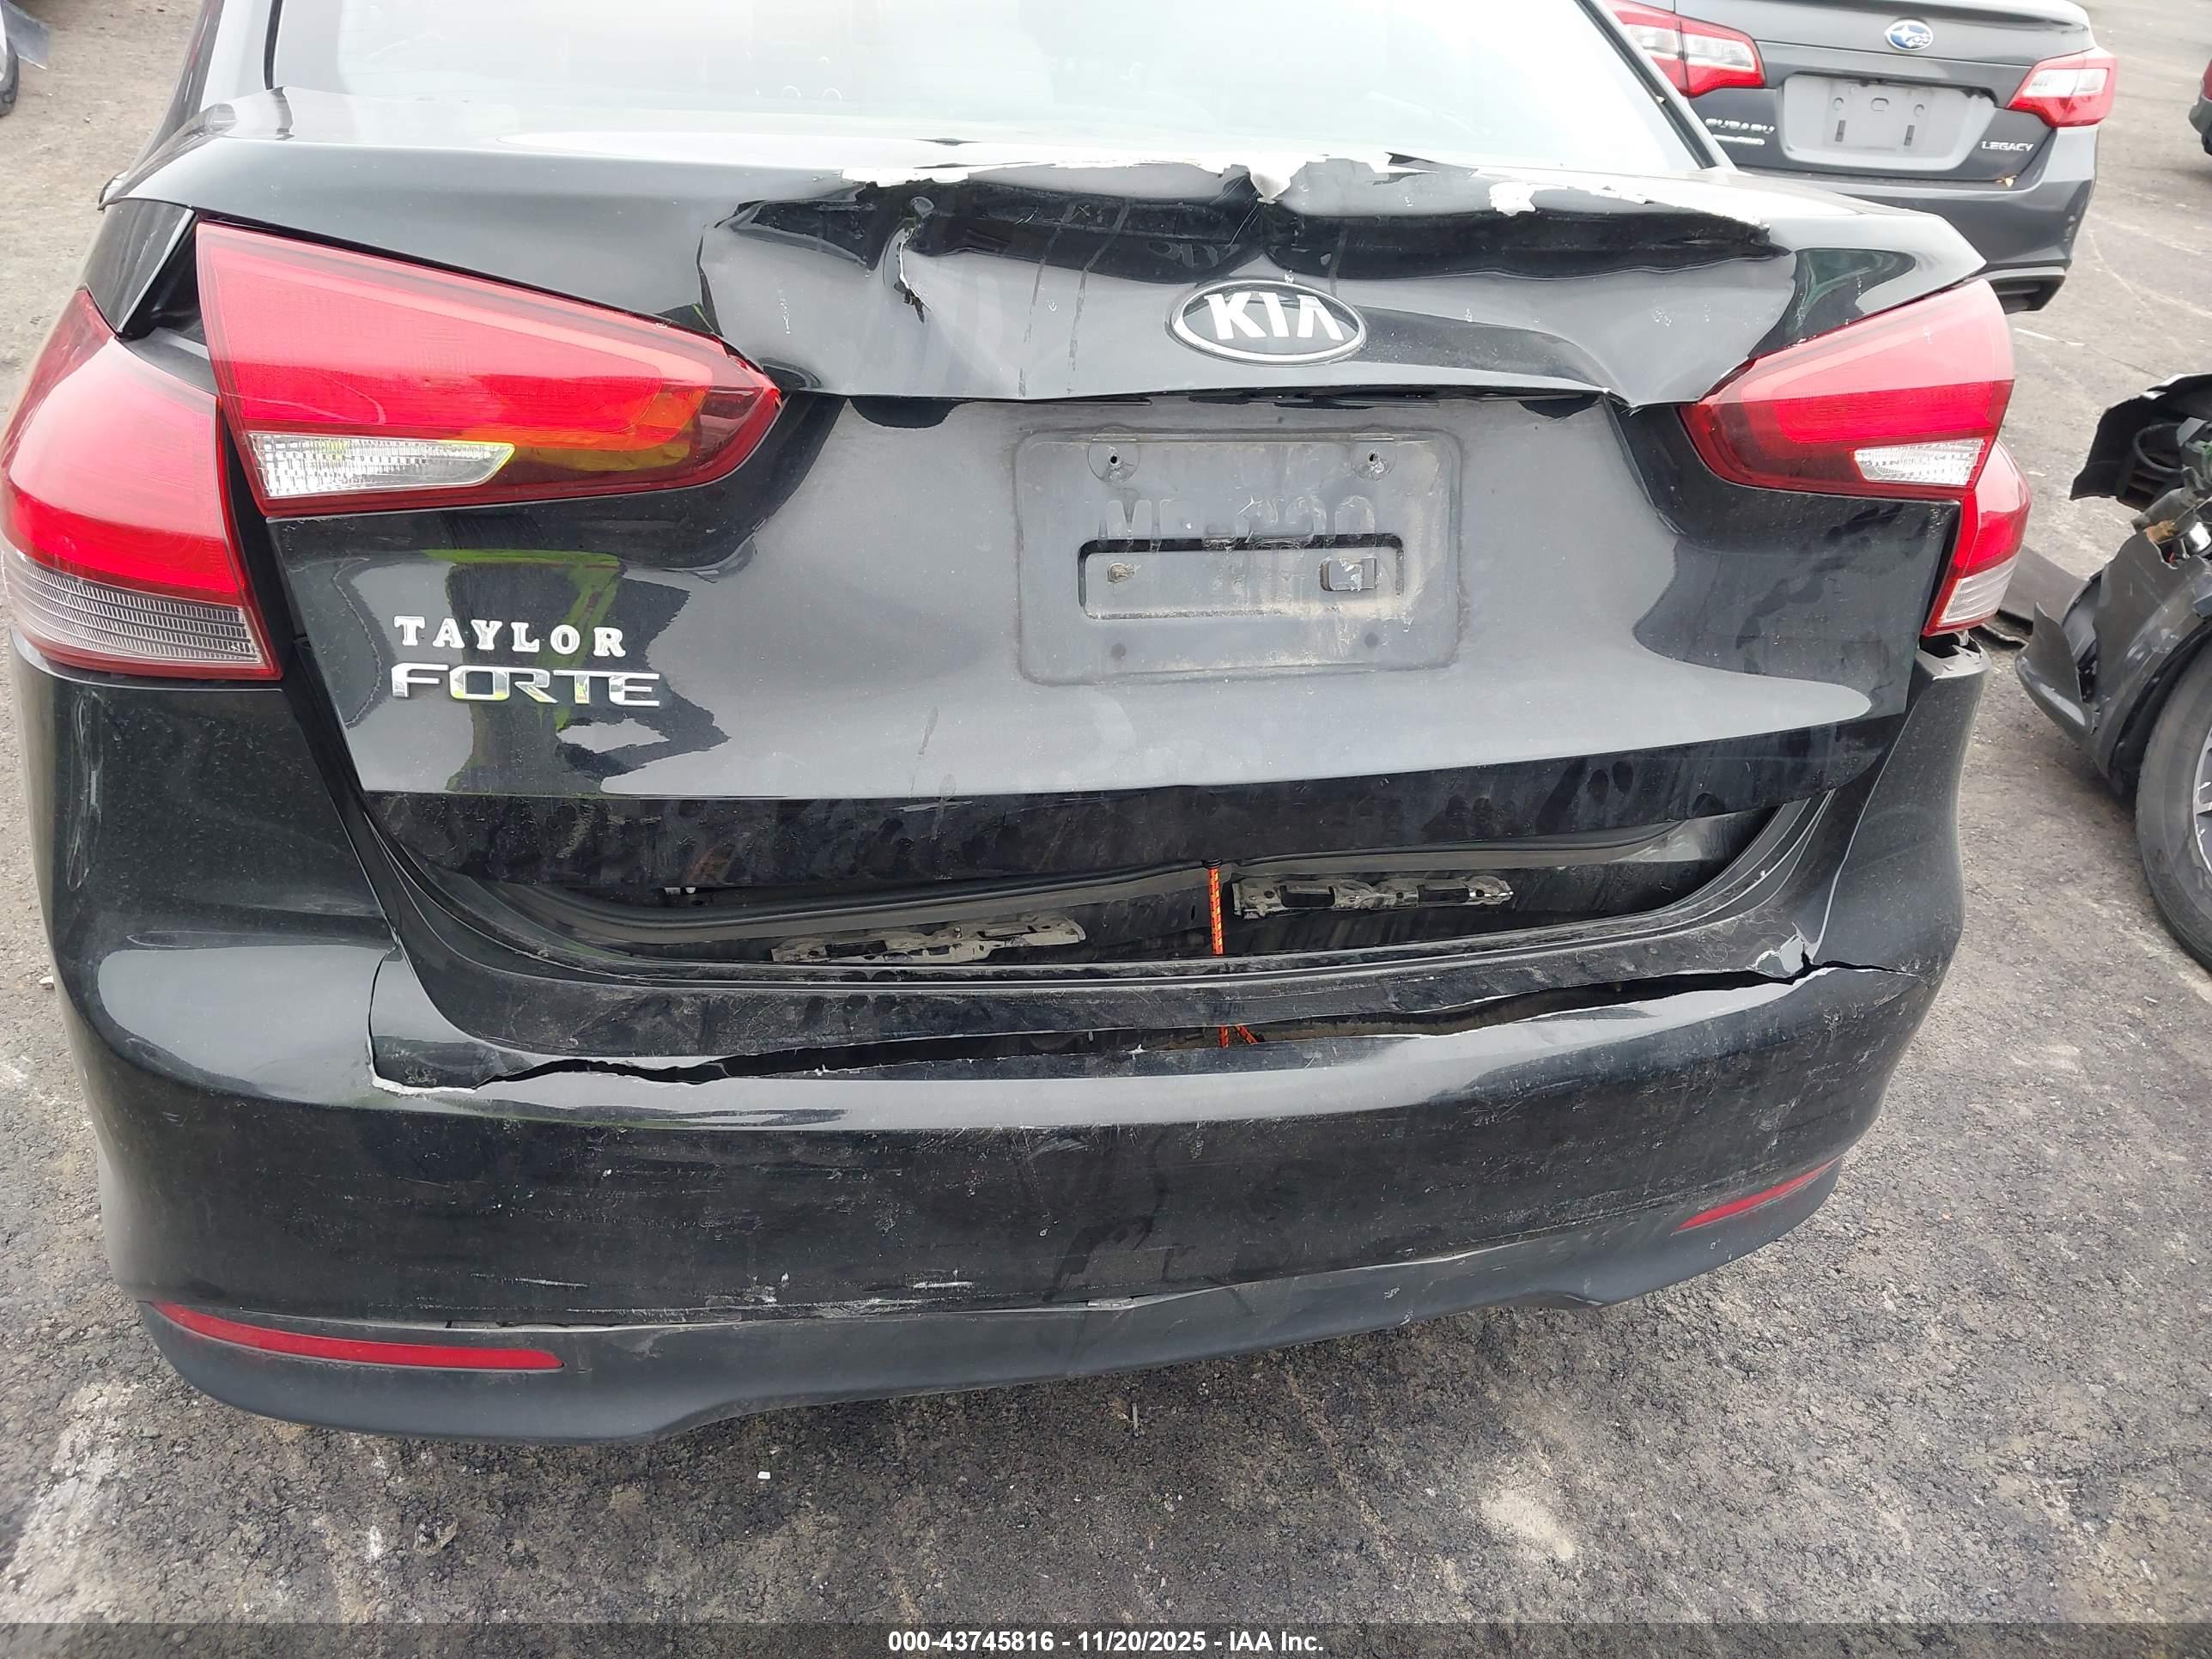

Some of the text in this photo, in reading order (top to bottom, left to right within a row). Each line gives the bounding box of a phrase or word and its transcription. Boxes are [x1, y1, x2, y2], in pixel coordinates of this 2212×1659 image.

[1705, 118, 1775, 134] SUBARU
[1981, 141, 2034, 152] LEGACY
[1204, 291, 1345, 341] KIA
[393, 616, 627, 658] TAYLOR
[391, 662, 660, 708] FORTE
